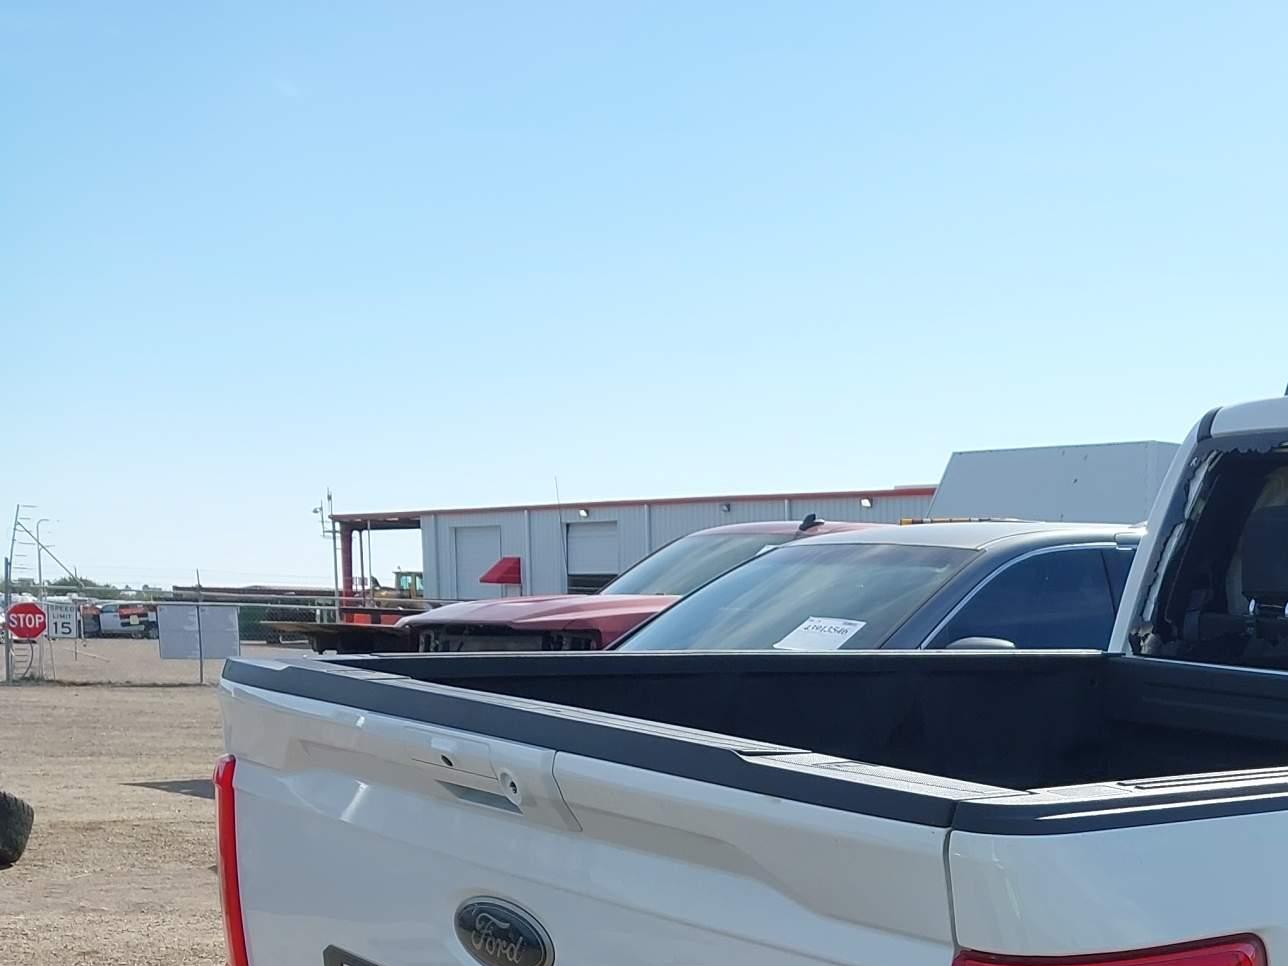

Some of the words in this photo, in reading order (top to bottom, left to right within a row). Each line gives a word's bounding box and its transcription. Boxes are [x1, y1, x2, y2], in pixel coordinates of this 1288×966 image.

[9, 613, 45, 628] STOP
[53, 621, 72, 635] 15
[471, 912, 523, 964] Ford
